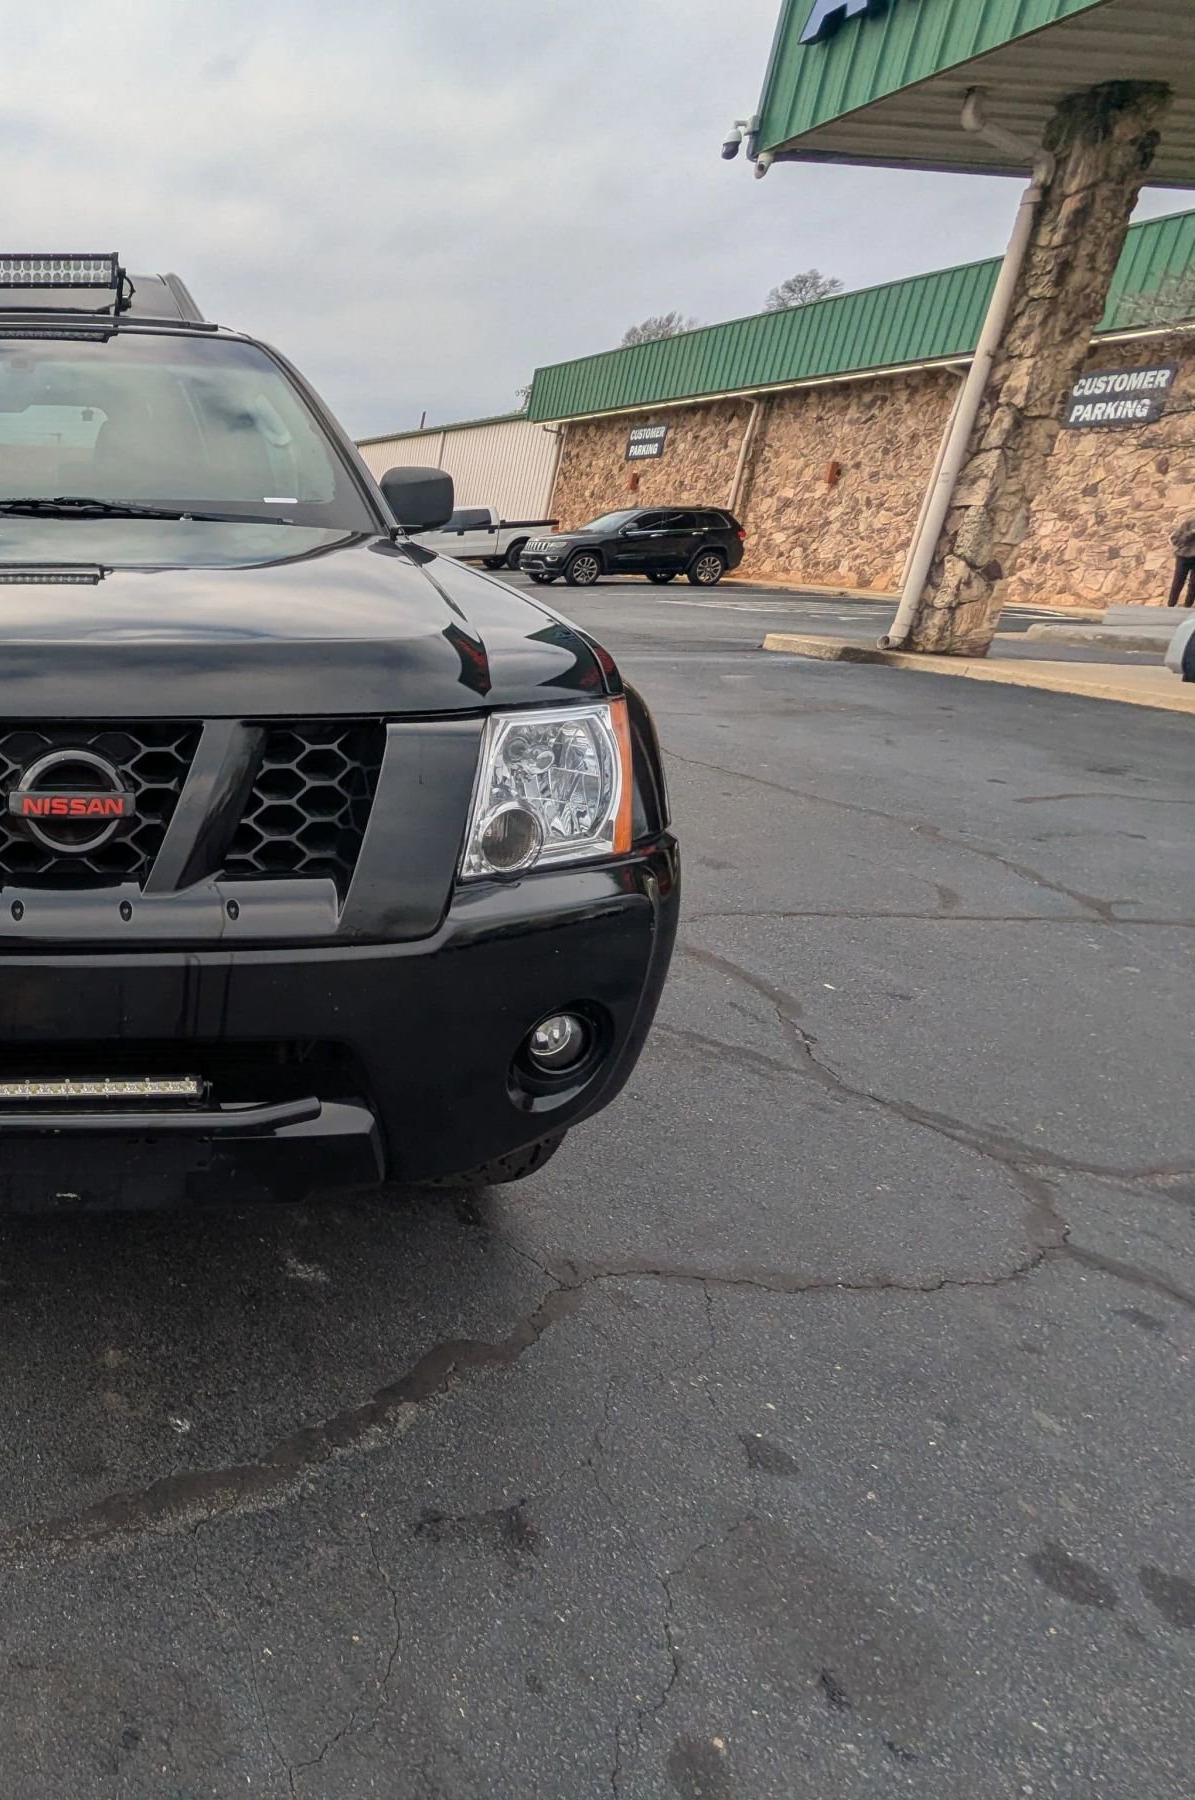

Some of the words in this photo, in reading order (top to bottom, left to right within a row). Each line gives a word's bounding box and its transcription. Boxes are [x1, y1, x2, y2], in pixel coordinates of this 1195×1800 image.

[1072, 369, 1171, 397] CUSTOMER
[1069, 398, 1151, 422] PARKING
[630, 426, 666, 440] CUSTOMER
[629, 443, 659, 456] PARKING
[22, 798, 124, 815] NISSAN
